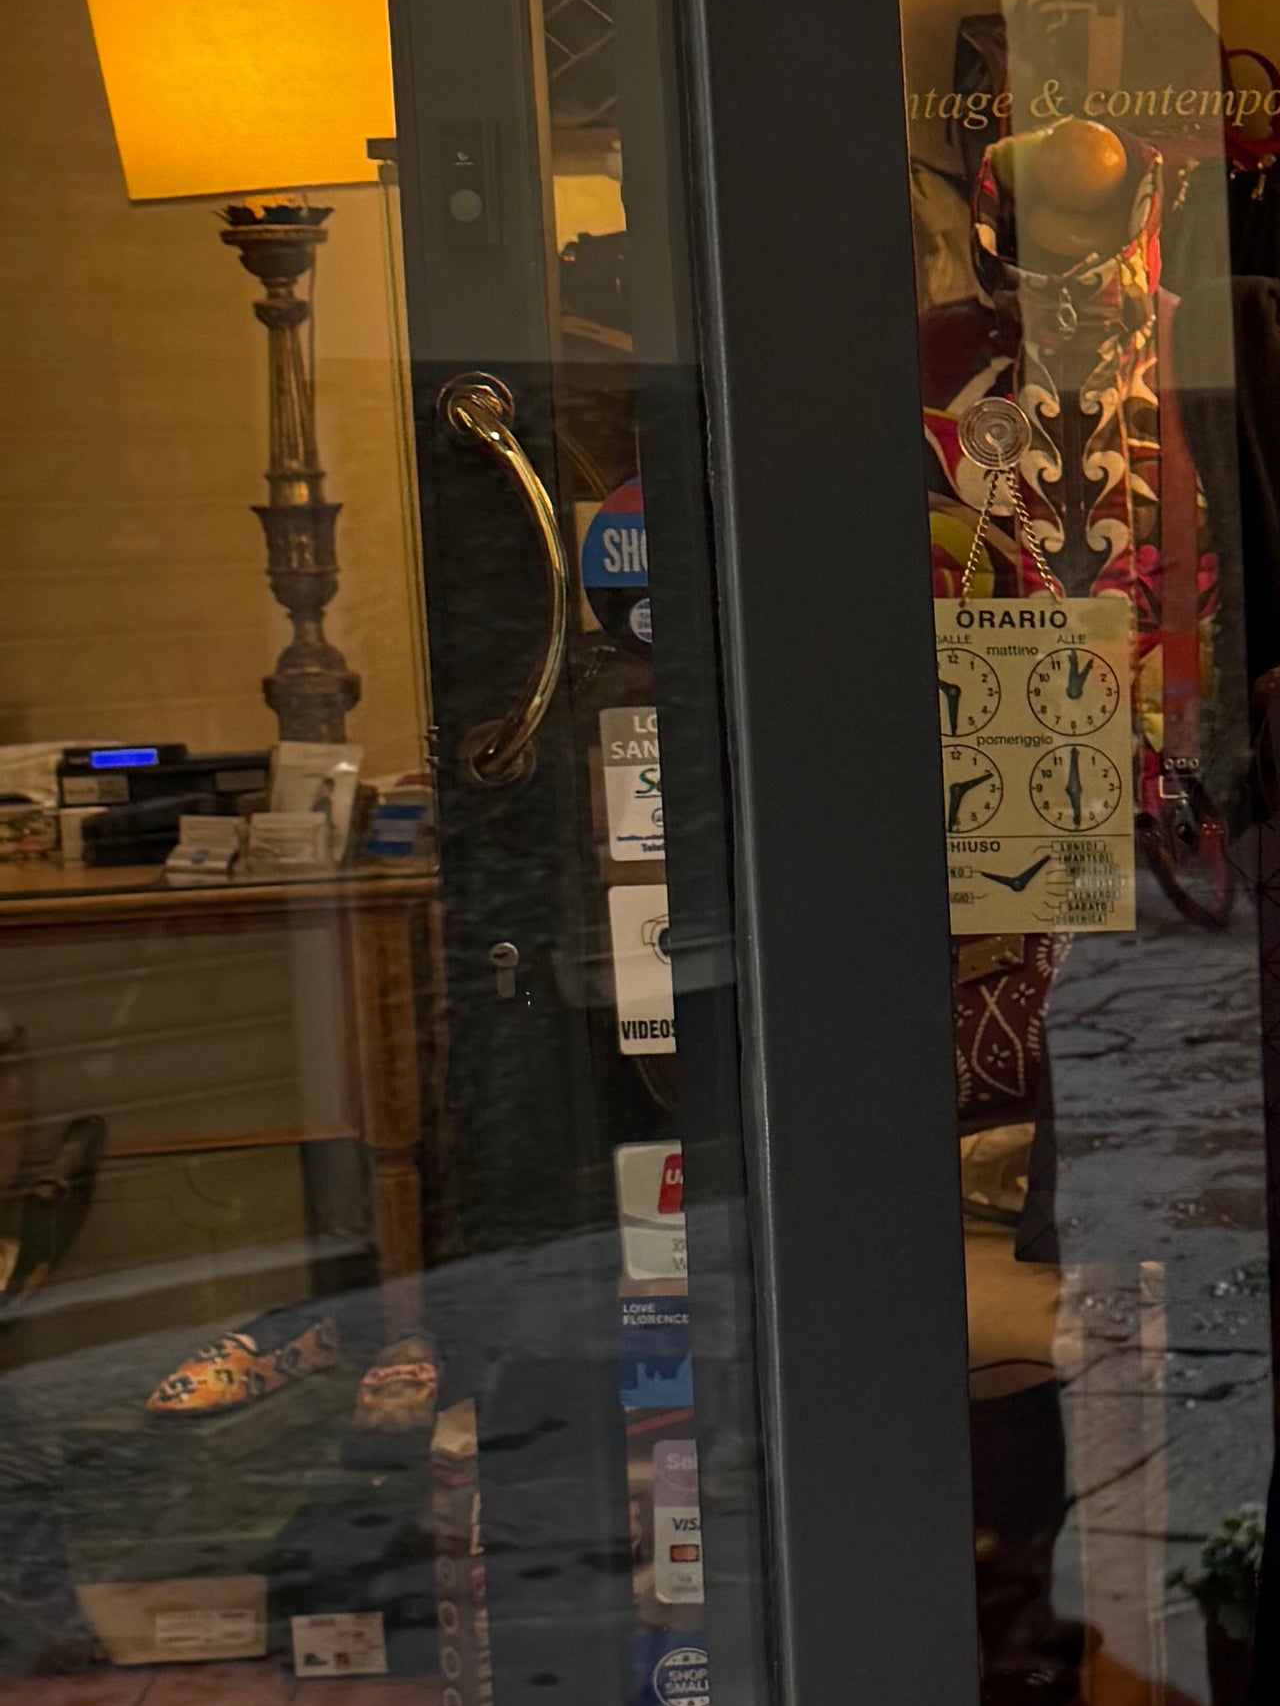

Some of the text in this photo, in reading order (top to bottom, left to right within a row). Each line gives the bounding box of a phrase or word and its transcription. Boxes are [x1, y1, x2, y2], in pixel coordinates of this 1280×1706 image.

[1030, 78, 1064, 118] &
[956, 609, 1068, 629] ORARIO
[1056, 634, 1087, 645] ALLE
[986, 644, 1039, 657] mattino
[976, 735, 1054, 748] pomeriggio
[671, 1516, 700, 1531] VIS
